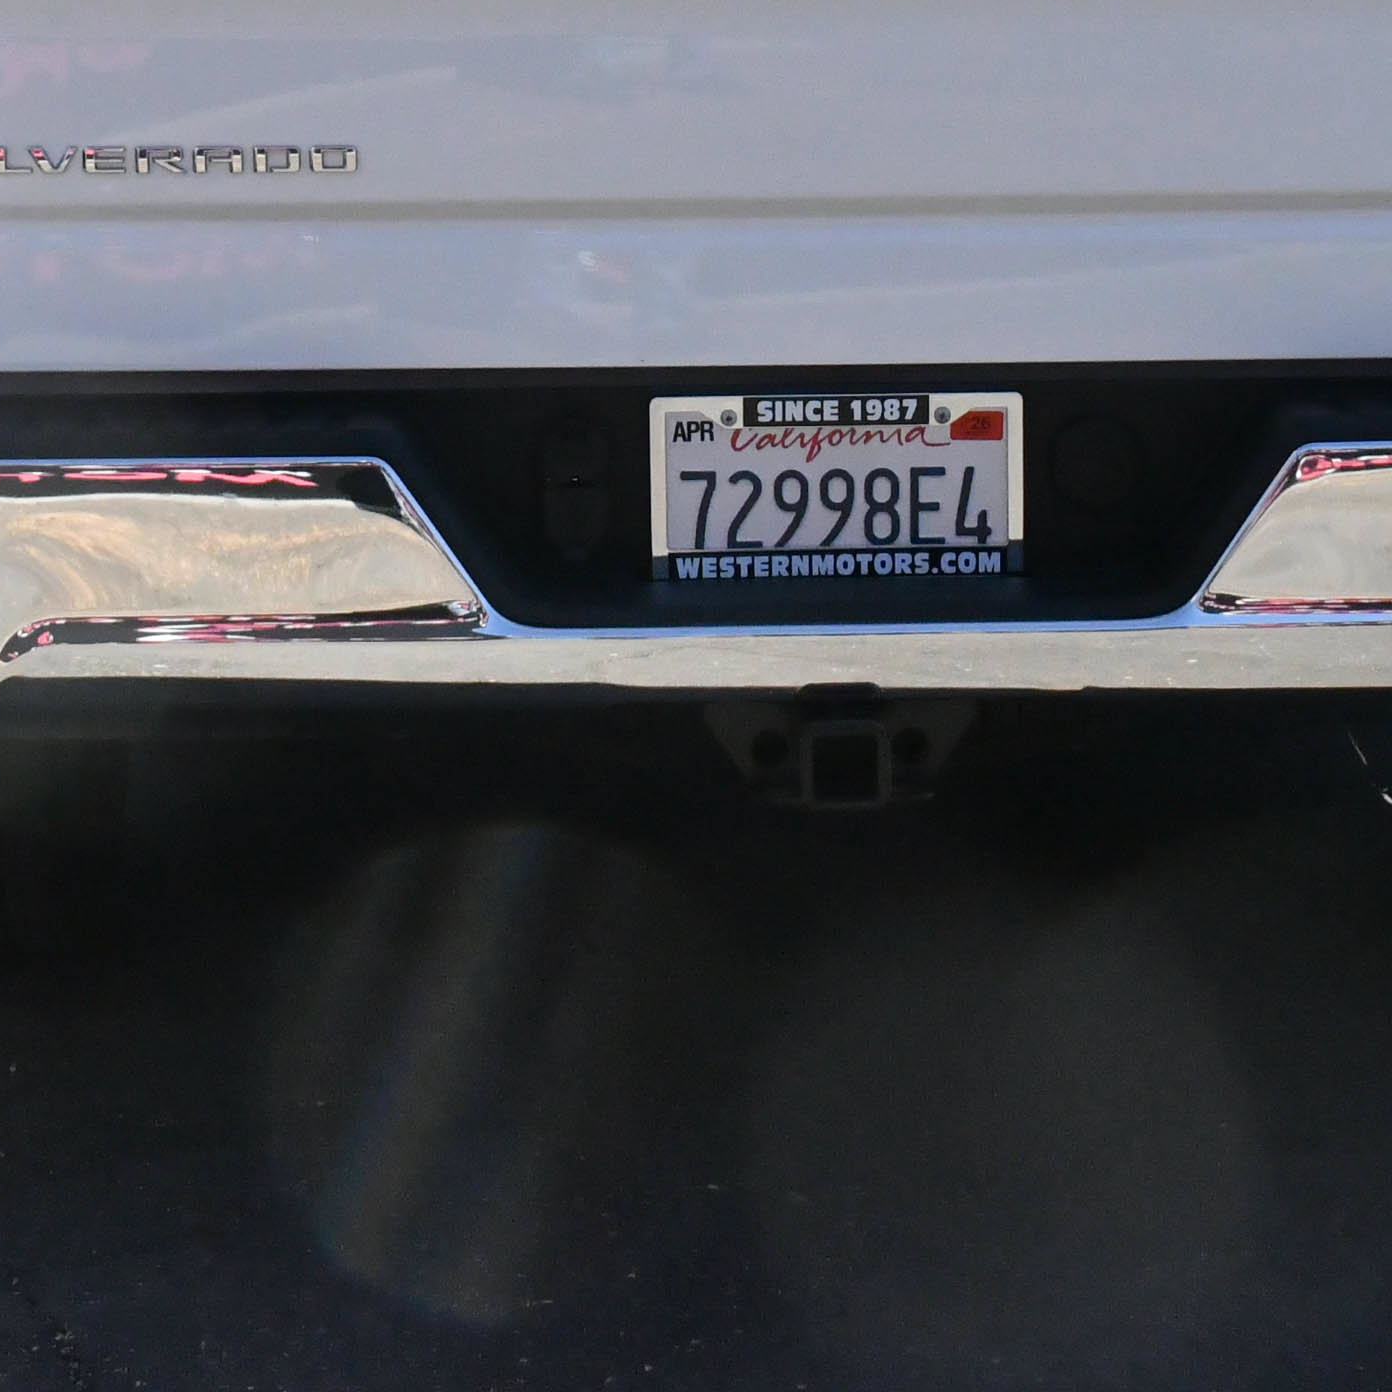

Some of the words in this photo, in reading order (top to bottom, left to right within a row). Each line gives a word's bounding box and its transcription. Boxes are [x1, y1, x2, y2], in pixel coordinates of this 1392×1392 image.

[756, 399, 840, 423] SINCE
[850, 398, 918, 422] 1987
[672, 421, 715, 443] APR
[731, 426, 951, 463] California
[680, 466, 992, 549] 72998E4
[676, 552, 1002, 580] WESTERNMOTORS.COM
